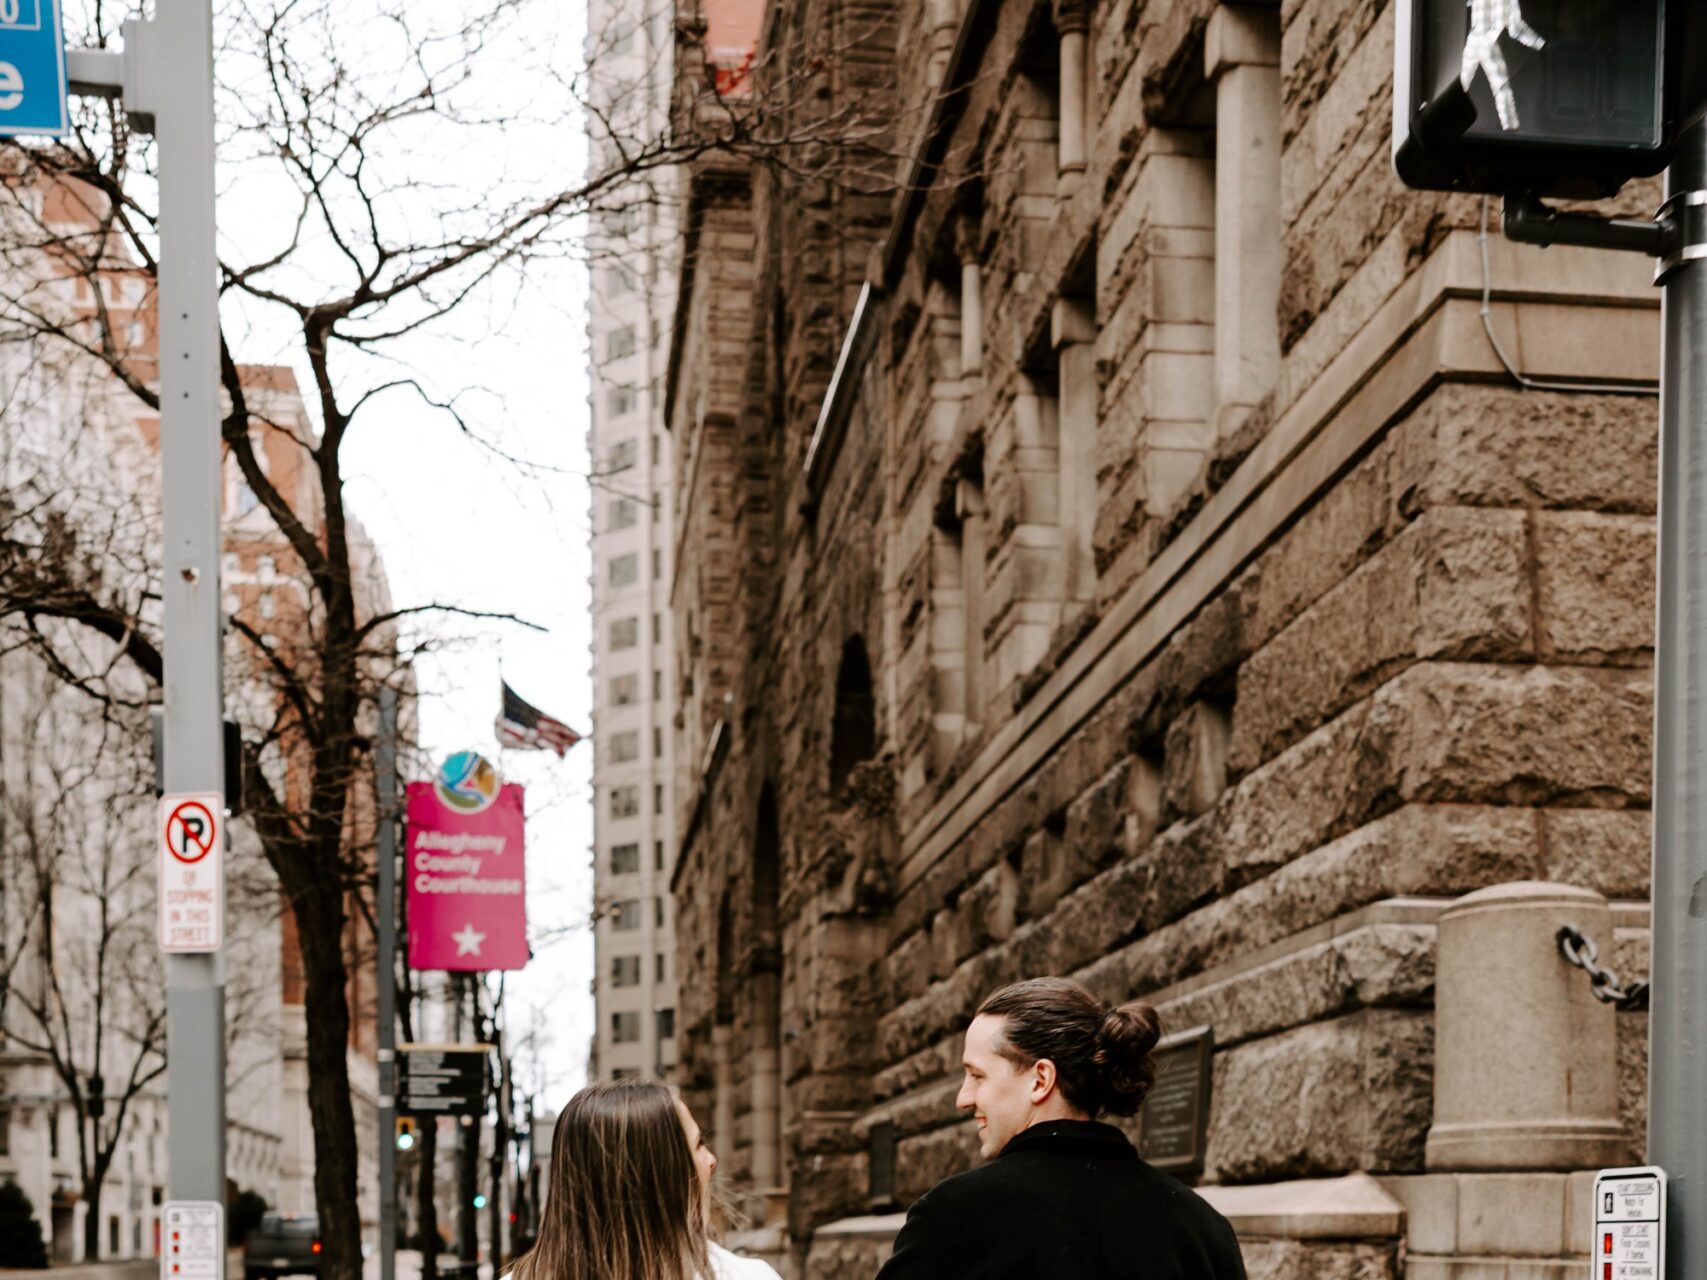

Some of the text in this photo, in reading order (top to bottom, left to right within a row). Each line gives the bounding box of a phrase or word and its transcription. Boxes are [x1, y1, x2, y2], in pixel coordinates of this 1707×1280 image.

[414, 830, 507, 856] Allegheny
[414, 851, 482, 876] County
[414, 873, 521, 895] Courthouse
